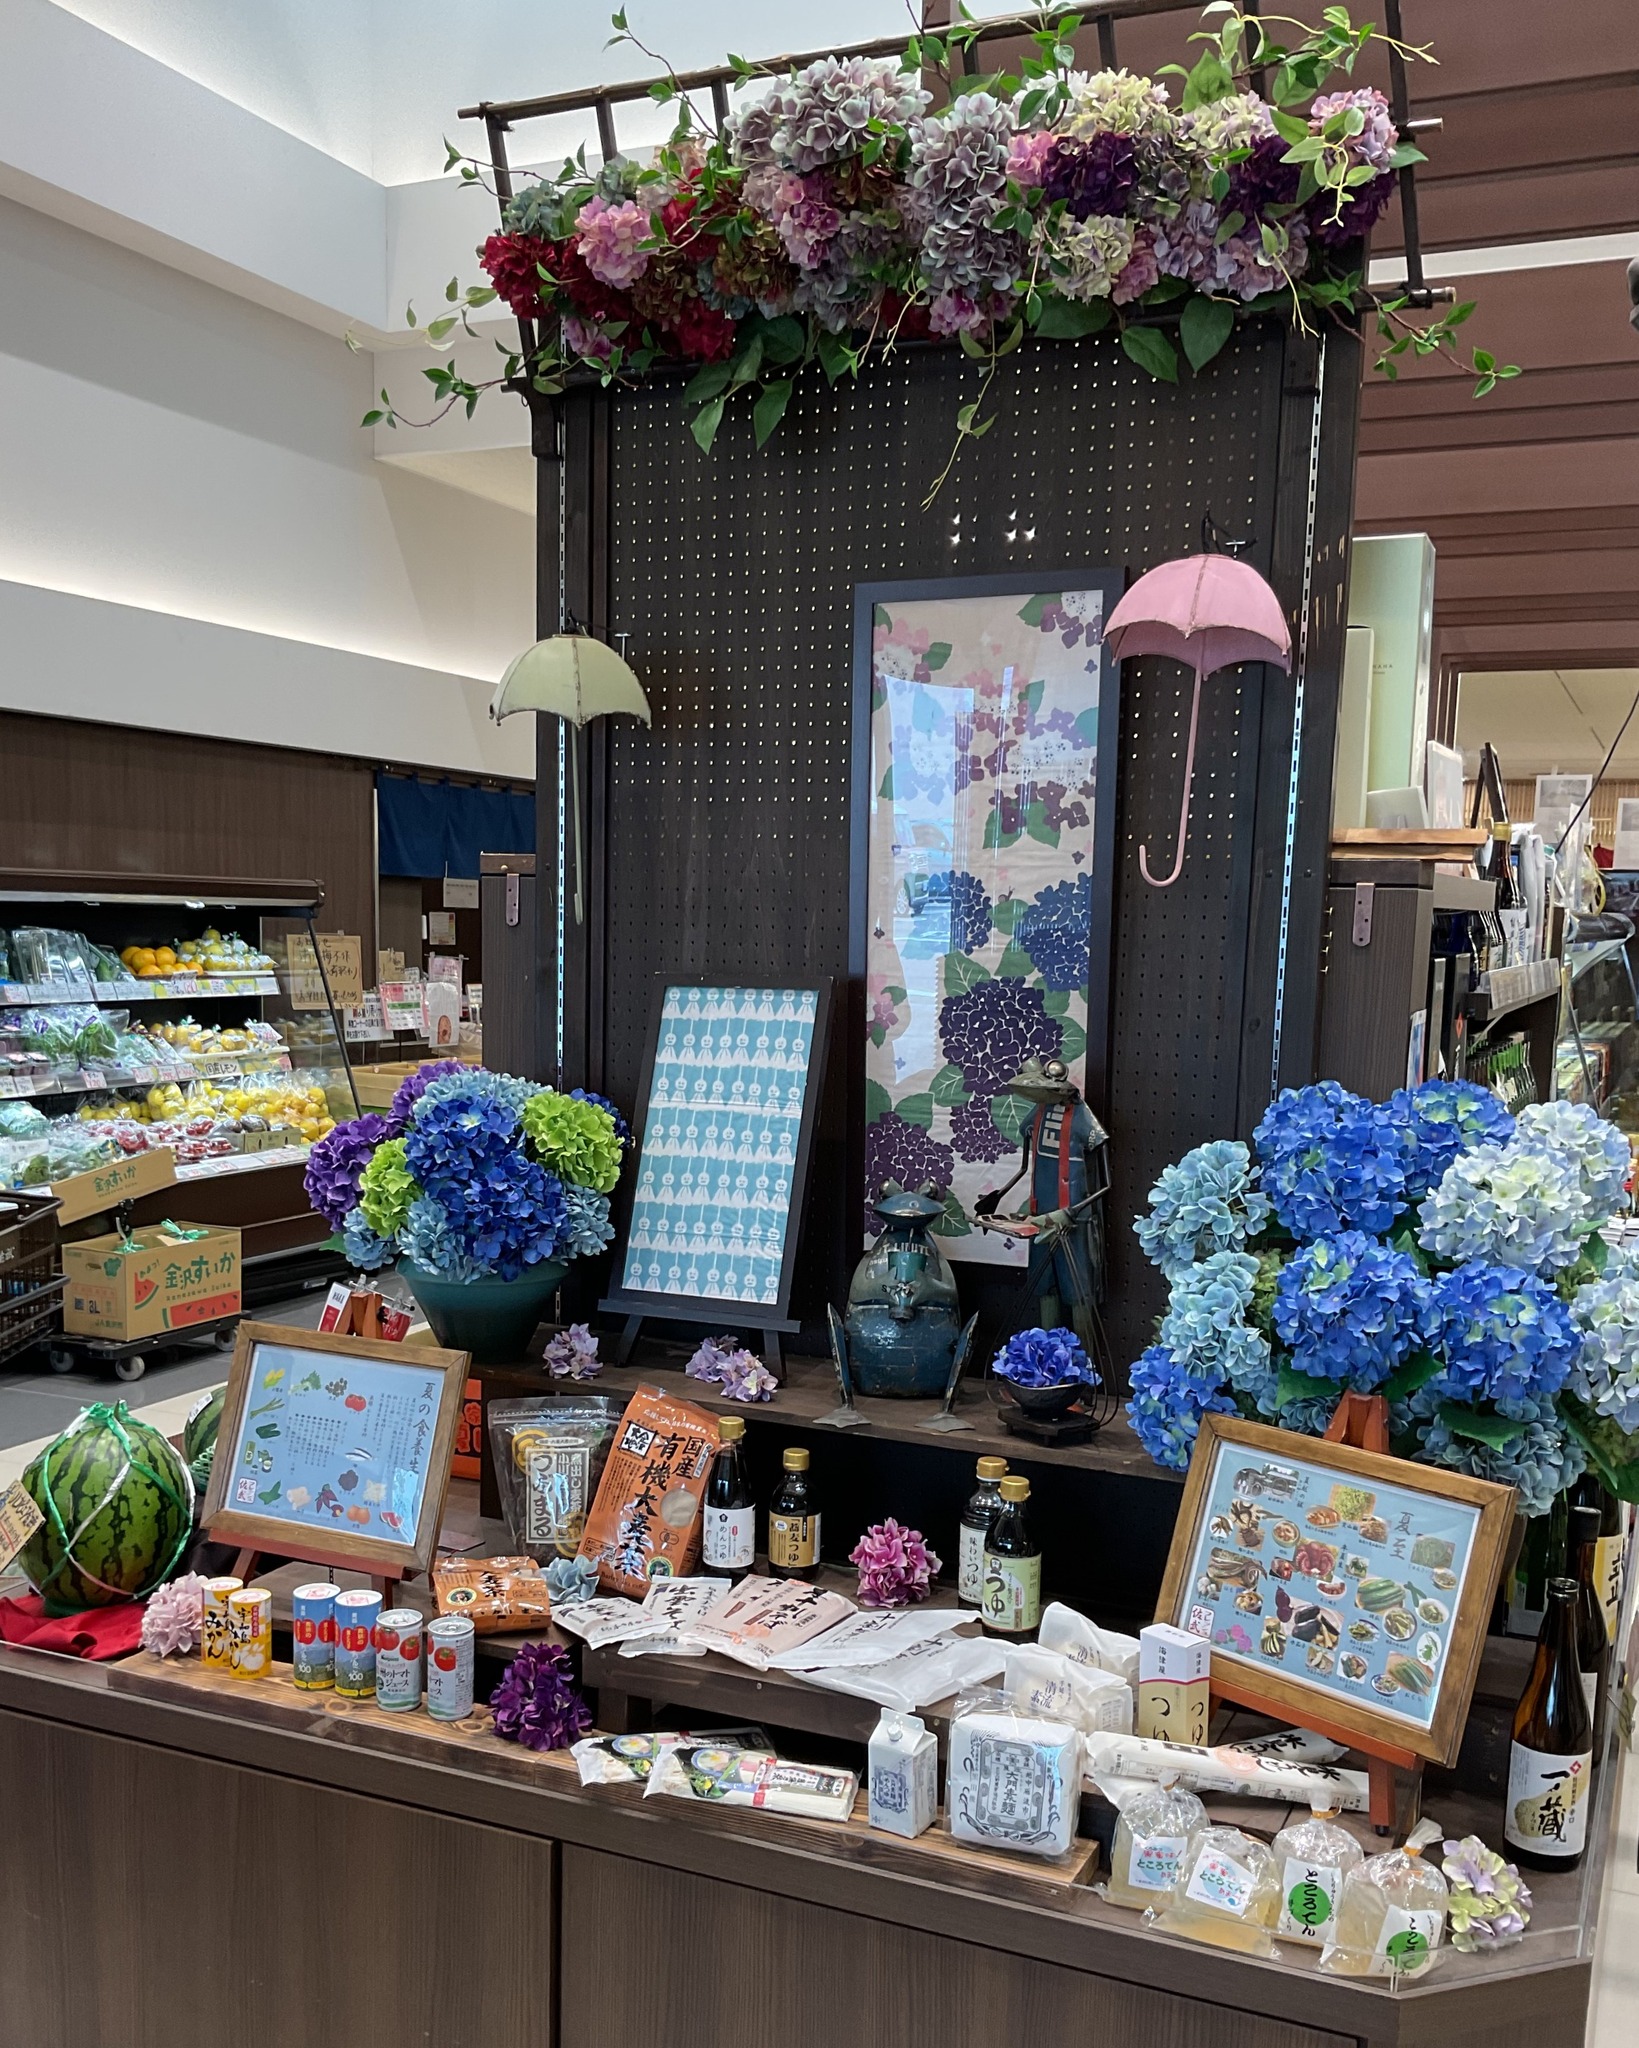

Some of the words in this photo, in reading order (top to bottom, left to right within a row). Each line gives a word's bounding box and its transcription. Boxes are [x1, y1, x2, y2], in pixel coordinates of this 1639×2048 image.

[93, 1166, 136, 1193] 金沢すいか
[164, 1252, 236, 1290] 金沢すいか
[410, 1382, 436, 1474] 夏の食養生
[673, 1435, 706, 1480] 国産
[719, 1526, 728, 1560] めんつゆ
[1389, 1511, 1414, 1560] 夏至
[984, 1576, 1006, 1619] つゆ
[1001, 1771, 1019, 1816] 大門素麺
[1539, 1770, 1571, 1843] 一ノ蔵
[1137, 1858, 1182, 1870] ところてん
[1199, 1870, 1245, 1895] ところてん
[1302, 1868, 1318, 1937] ところてん
